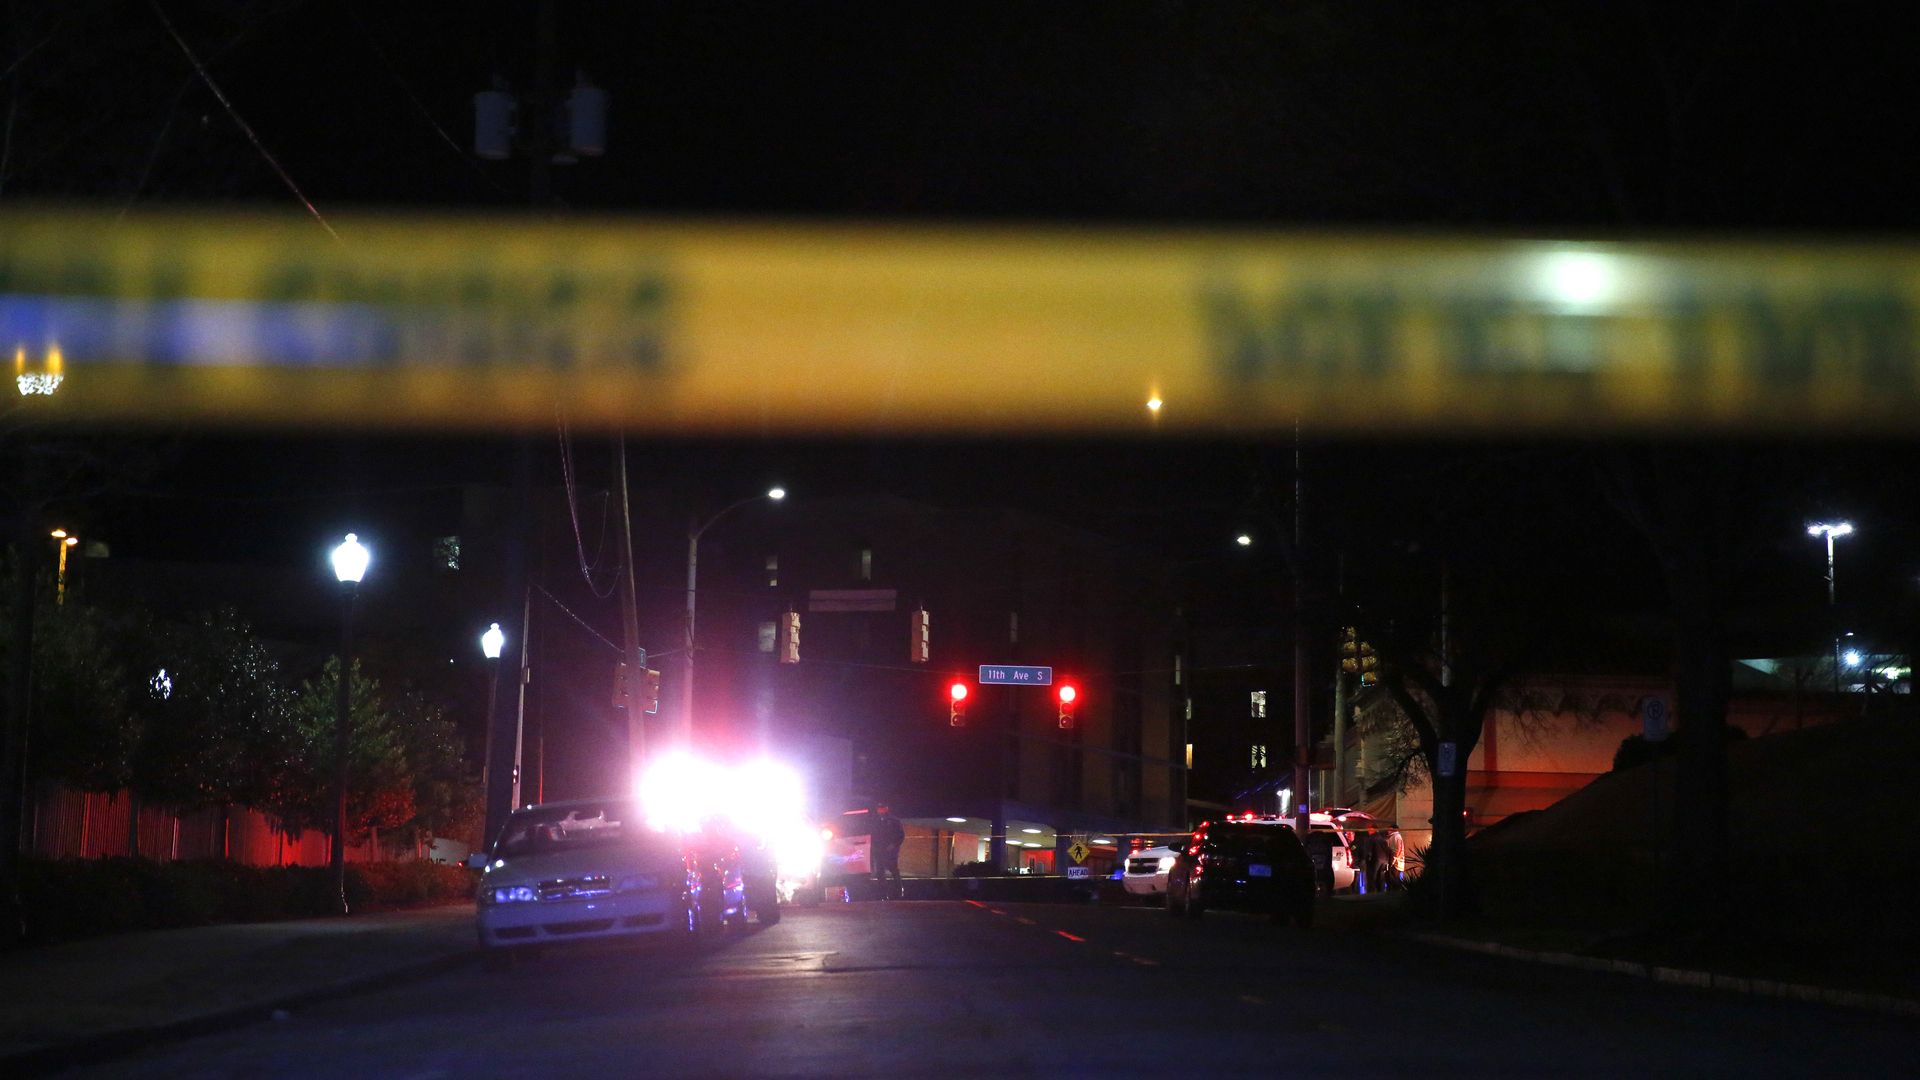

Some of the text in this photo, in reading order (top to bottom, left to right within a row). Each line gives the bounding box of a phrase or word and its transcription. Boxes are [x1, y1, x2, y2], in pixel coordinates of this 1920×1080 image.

[988, 669, 1043, 680] 11th Ave S
[1069, 869, 1088, 877] AHEAD
